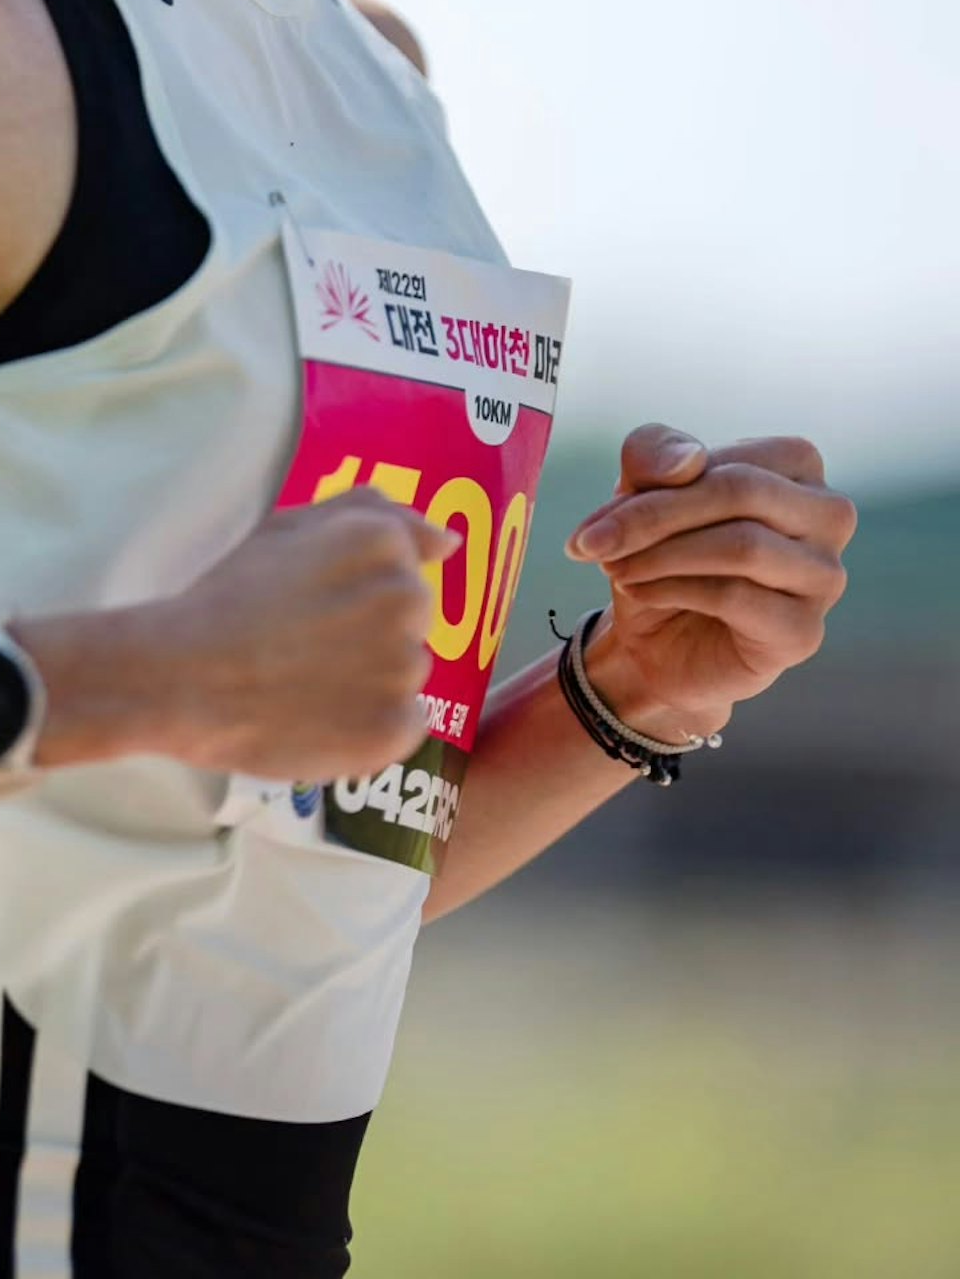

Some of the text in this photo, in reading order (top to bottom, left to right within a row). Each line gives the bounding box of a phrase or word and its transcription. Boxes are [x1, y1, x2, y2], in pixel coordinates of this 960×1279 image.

[376, 268, 427, 302] 제22회
[384, 303, 439, 356] 대전
[441, 315, 531, 377] 3대하천
[474, 395, 512, 427] 10KM
